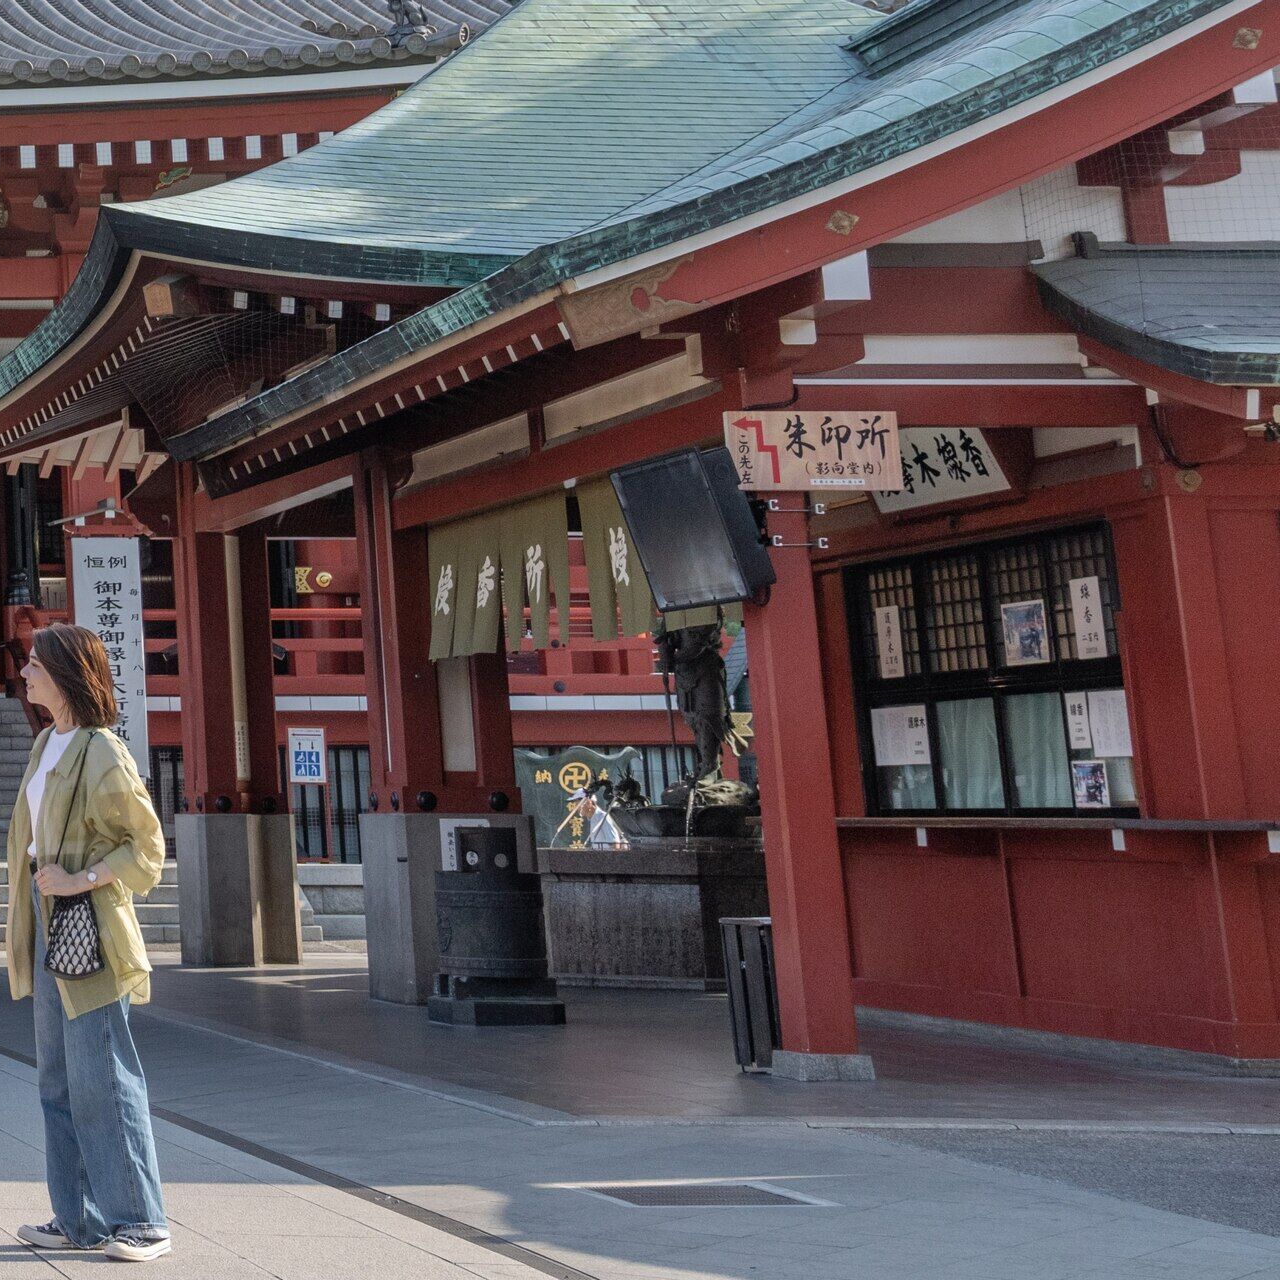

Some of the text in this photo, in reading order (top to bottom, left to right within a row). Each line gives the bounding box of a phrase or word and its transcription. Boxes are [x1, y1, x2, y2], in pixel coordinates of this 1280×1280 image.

[738, 434, 754, 485] この先左
[783, 414, 891, 461] 朱印所
[83, 554, 128, 570] 恒例
